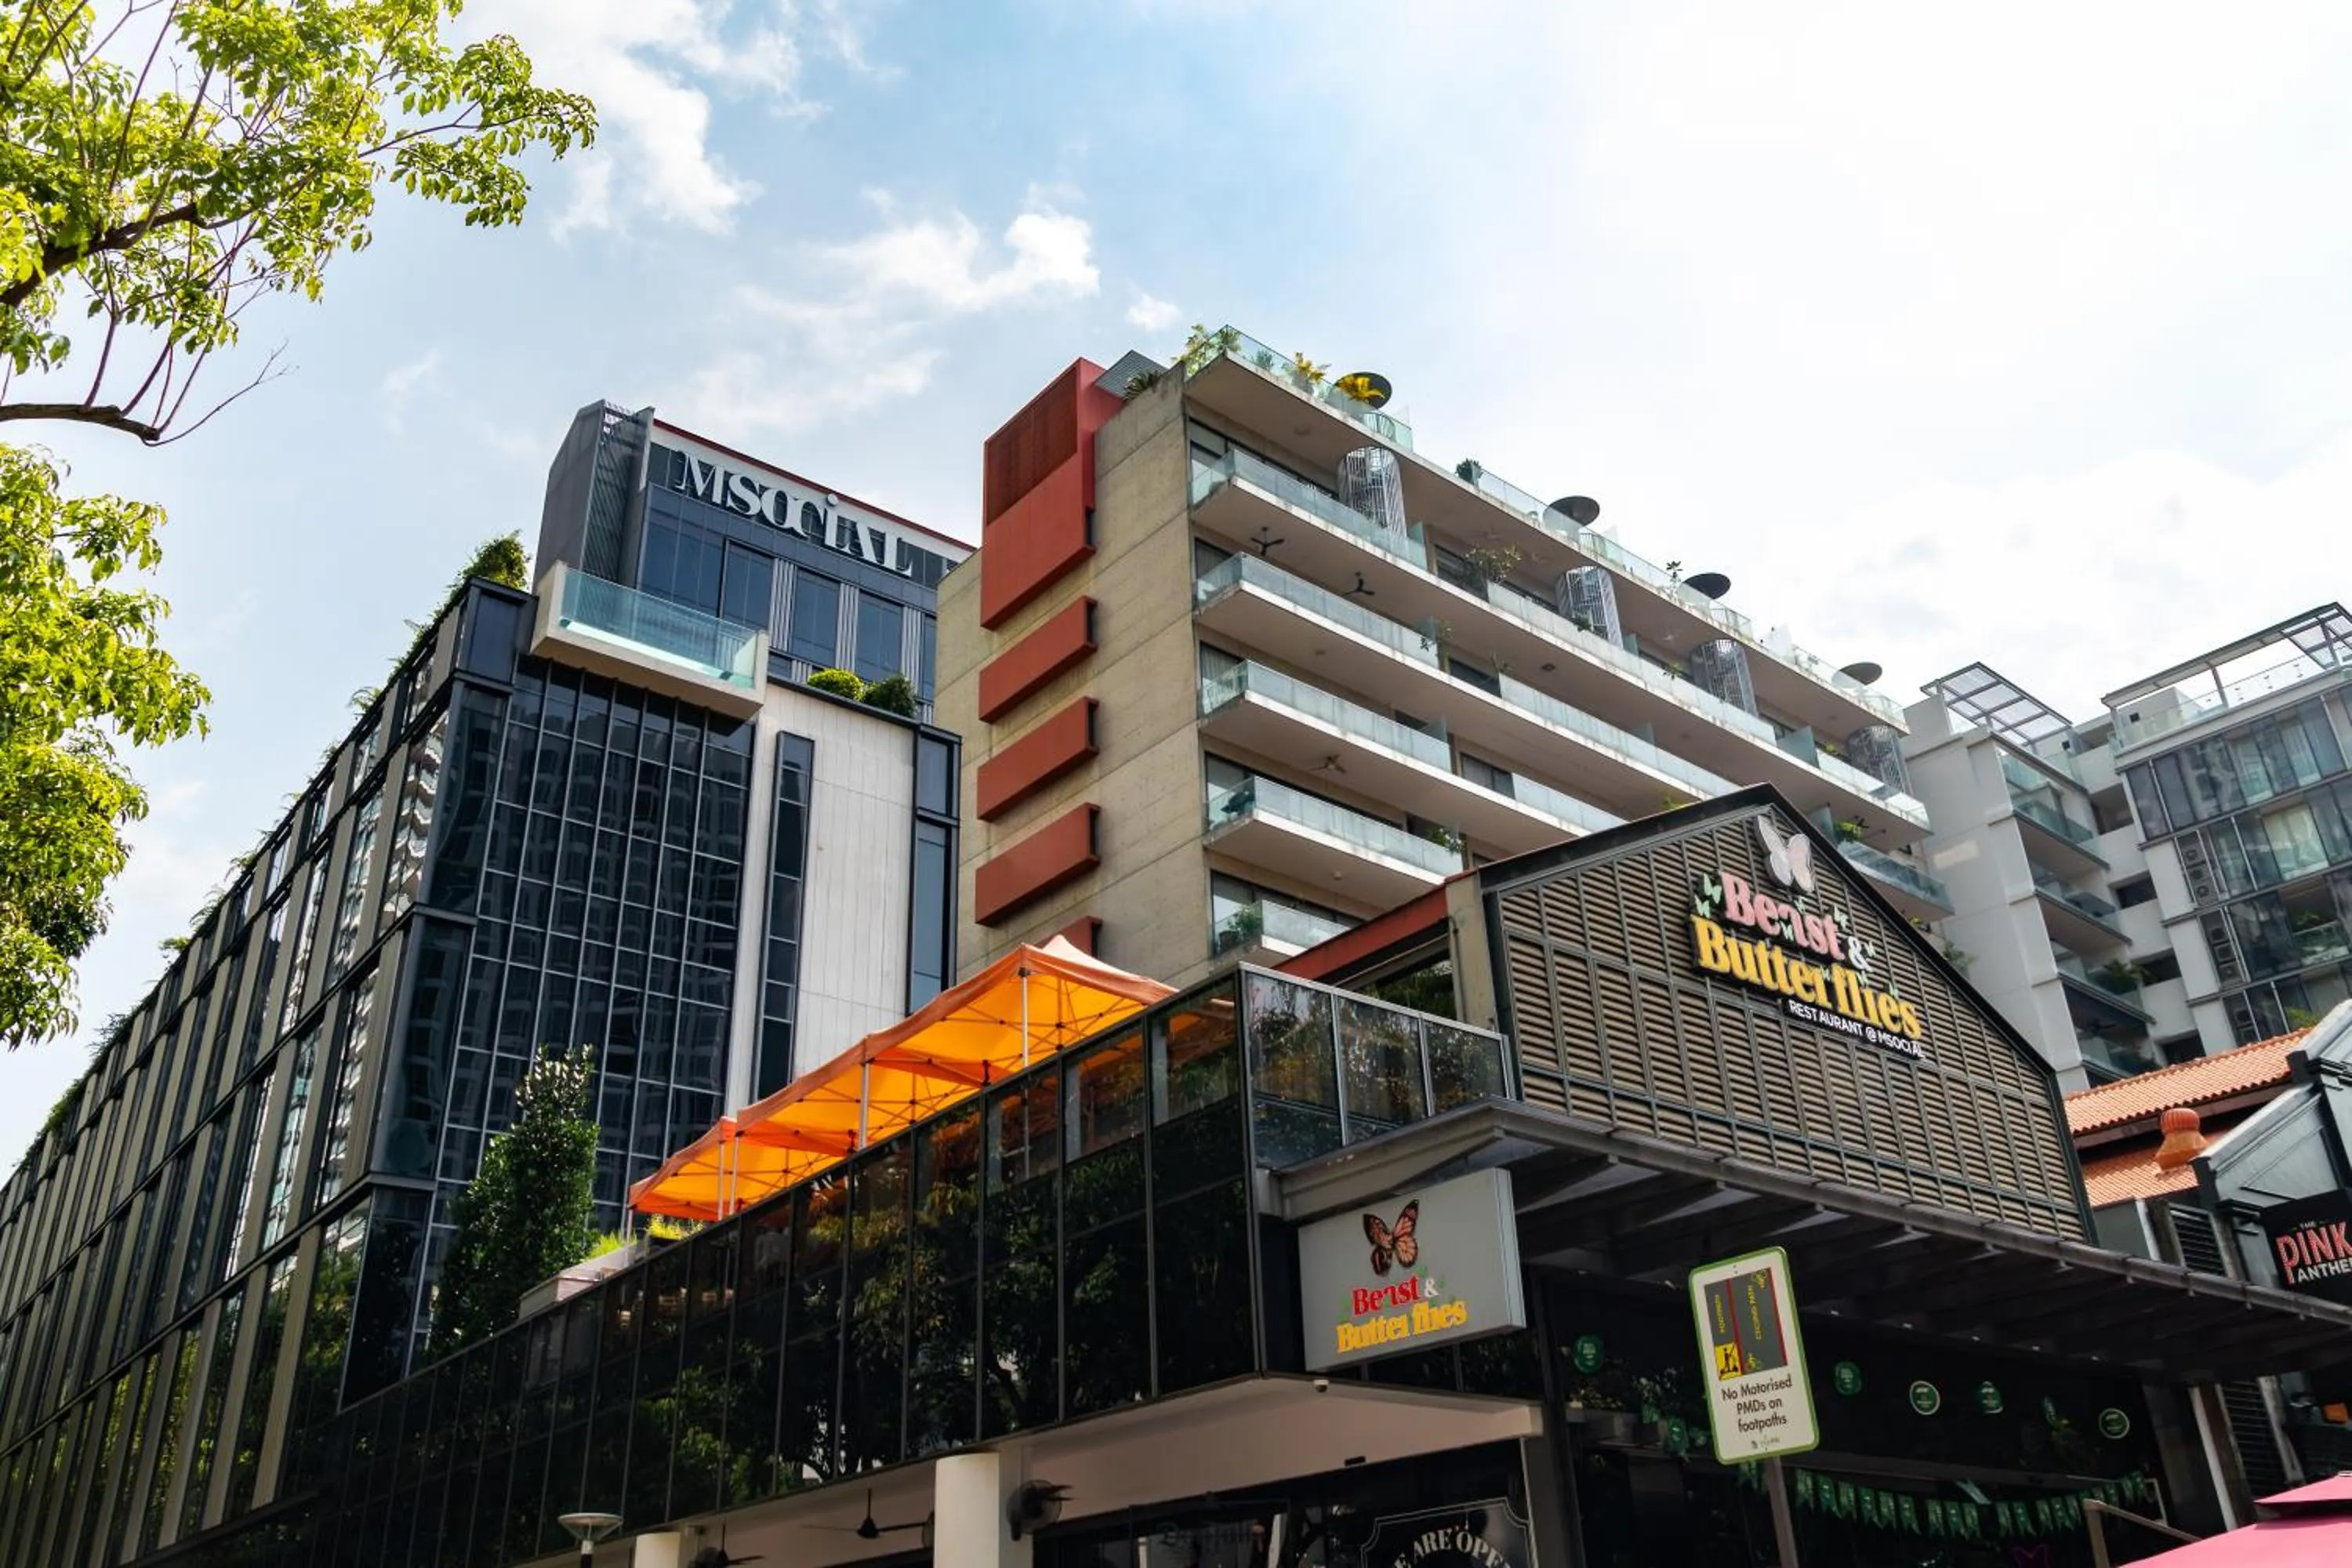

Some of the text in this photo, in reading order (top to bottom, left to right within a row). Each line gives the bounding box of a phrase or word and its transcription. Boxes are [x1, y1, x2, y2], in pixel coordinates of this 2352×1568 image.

[1721, 871, 1873, 973] Beast &
[1788, 999, 1864, 1036] RESTAURANT
[2275, 1224, 2352, 1284] PINK
[1423, 1276, 1439, 1298] &
[1721, 1375, 1793, 1401] No Motorised
[1737, 1398, 1783, 1415] PMDs on
[1737, 1410, 1788, 1434] footpaths
[1413, 1528, 1453, 1564] ARE
[1456, 1531, 1511, 1568] OPE
